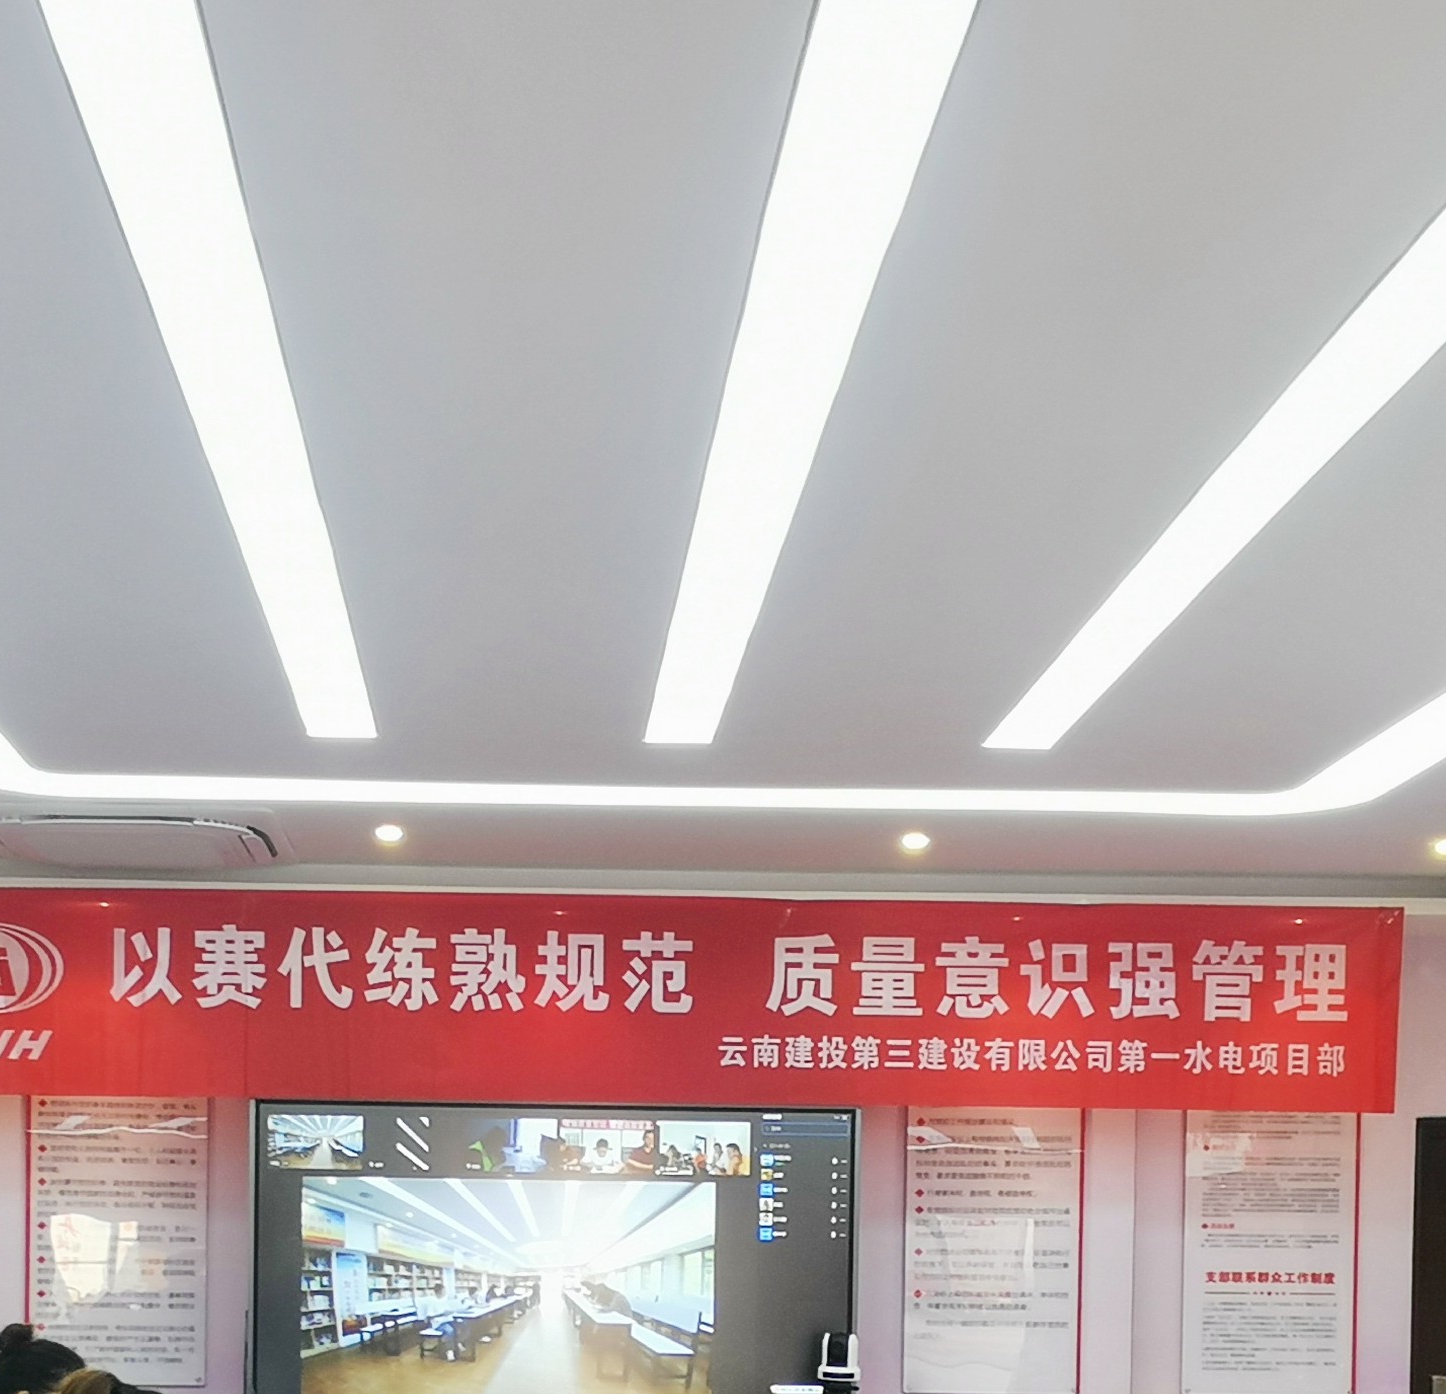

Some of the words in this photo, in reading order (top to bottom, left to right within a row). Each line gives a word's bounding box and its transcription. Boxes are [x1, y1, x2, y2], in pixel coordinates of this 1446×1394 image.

[109, 924, 694, 1013] 以赛代练熟规范
[764, 932, 1349, 1023] 质量意识强管理
[717, 1034, 1346, 1078] 云南建投第三建设有限公司第一水电项目部
